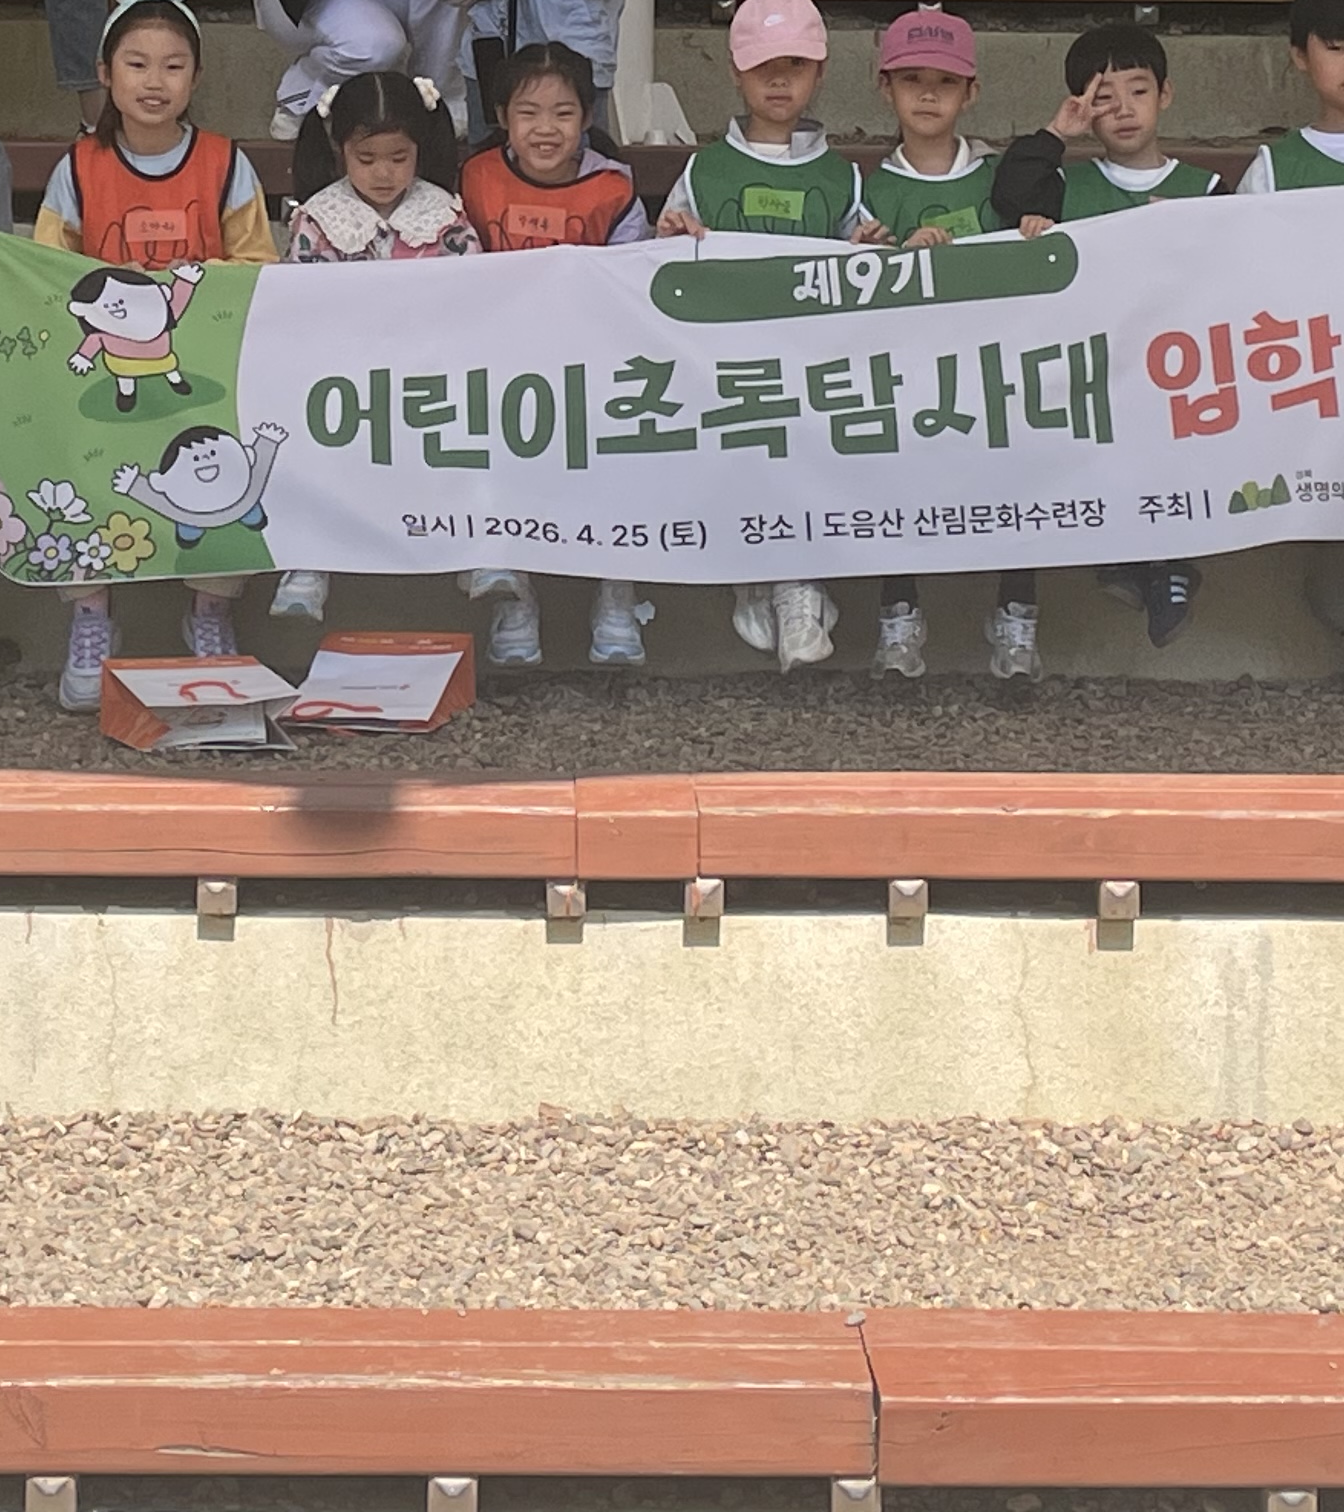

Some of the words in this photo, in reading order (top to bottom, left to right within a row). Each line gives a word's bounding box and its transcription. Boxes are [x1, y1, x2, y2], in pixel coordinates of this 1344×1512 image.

[793, 249, 935, 306] 제9기
[306, 332, 1114, 470] 어린이초록탐사대
[401, 514, 456, 537] 일시
[485, 517, 567, 543] 2026.
[576, 523, 603, 546] 4.
[611, 524, 649, 547] 25
[659, 519, 708, 551] (토)
[740, 514, 796, 545] 장소
[822, 508, 905, 540] 도음산
[913, 498, 1106, 537] 산림문화수련장
[1139, 491, 1193, 524] 주최
